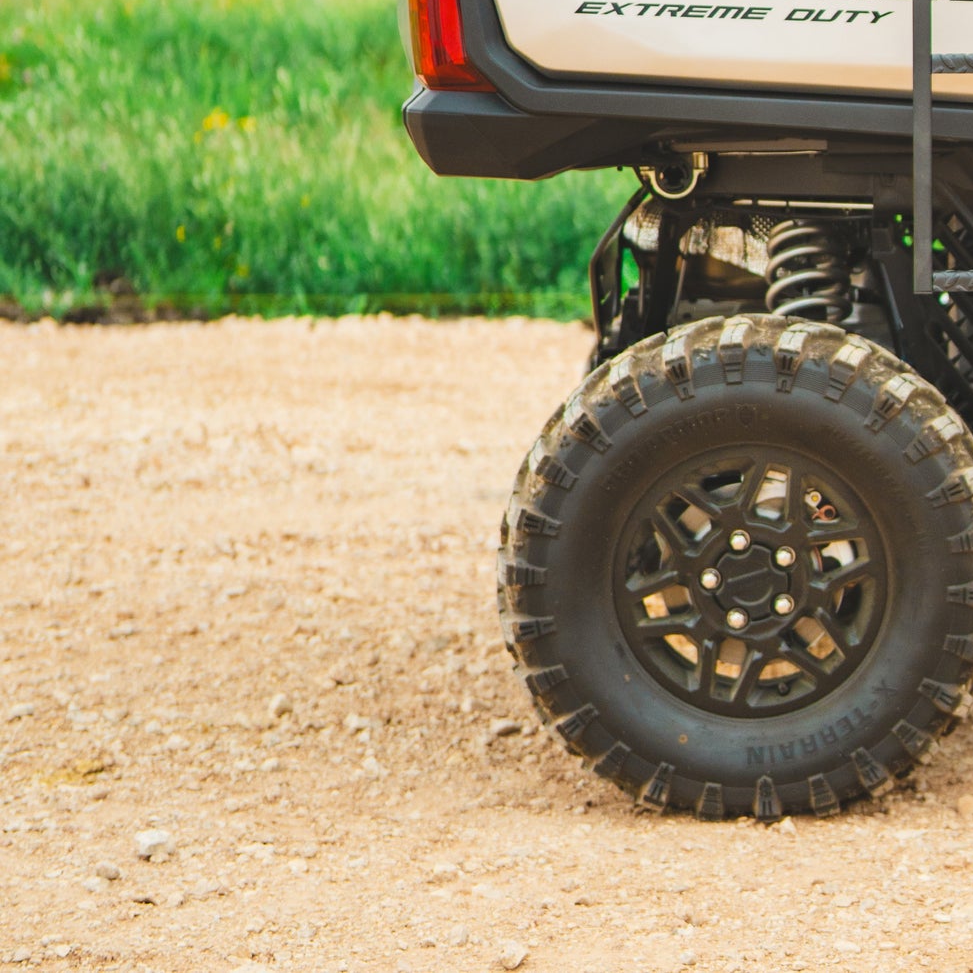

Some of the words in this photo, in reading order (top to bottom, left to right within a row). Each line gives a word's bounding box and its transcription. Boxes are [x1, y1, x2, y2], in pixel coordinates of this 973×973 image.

[574, 1, 773, 20] EXTREME
[784, 8, 895, 24] DUTY
[746, 678, 899, 765] X-TERRAIN
